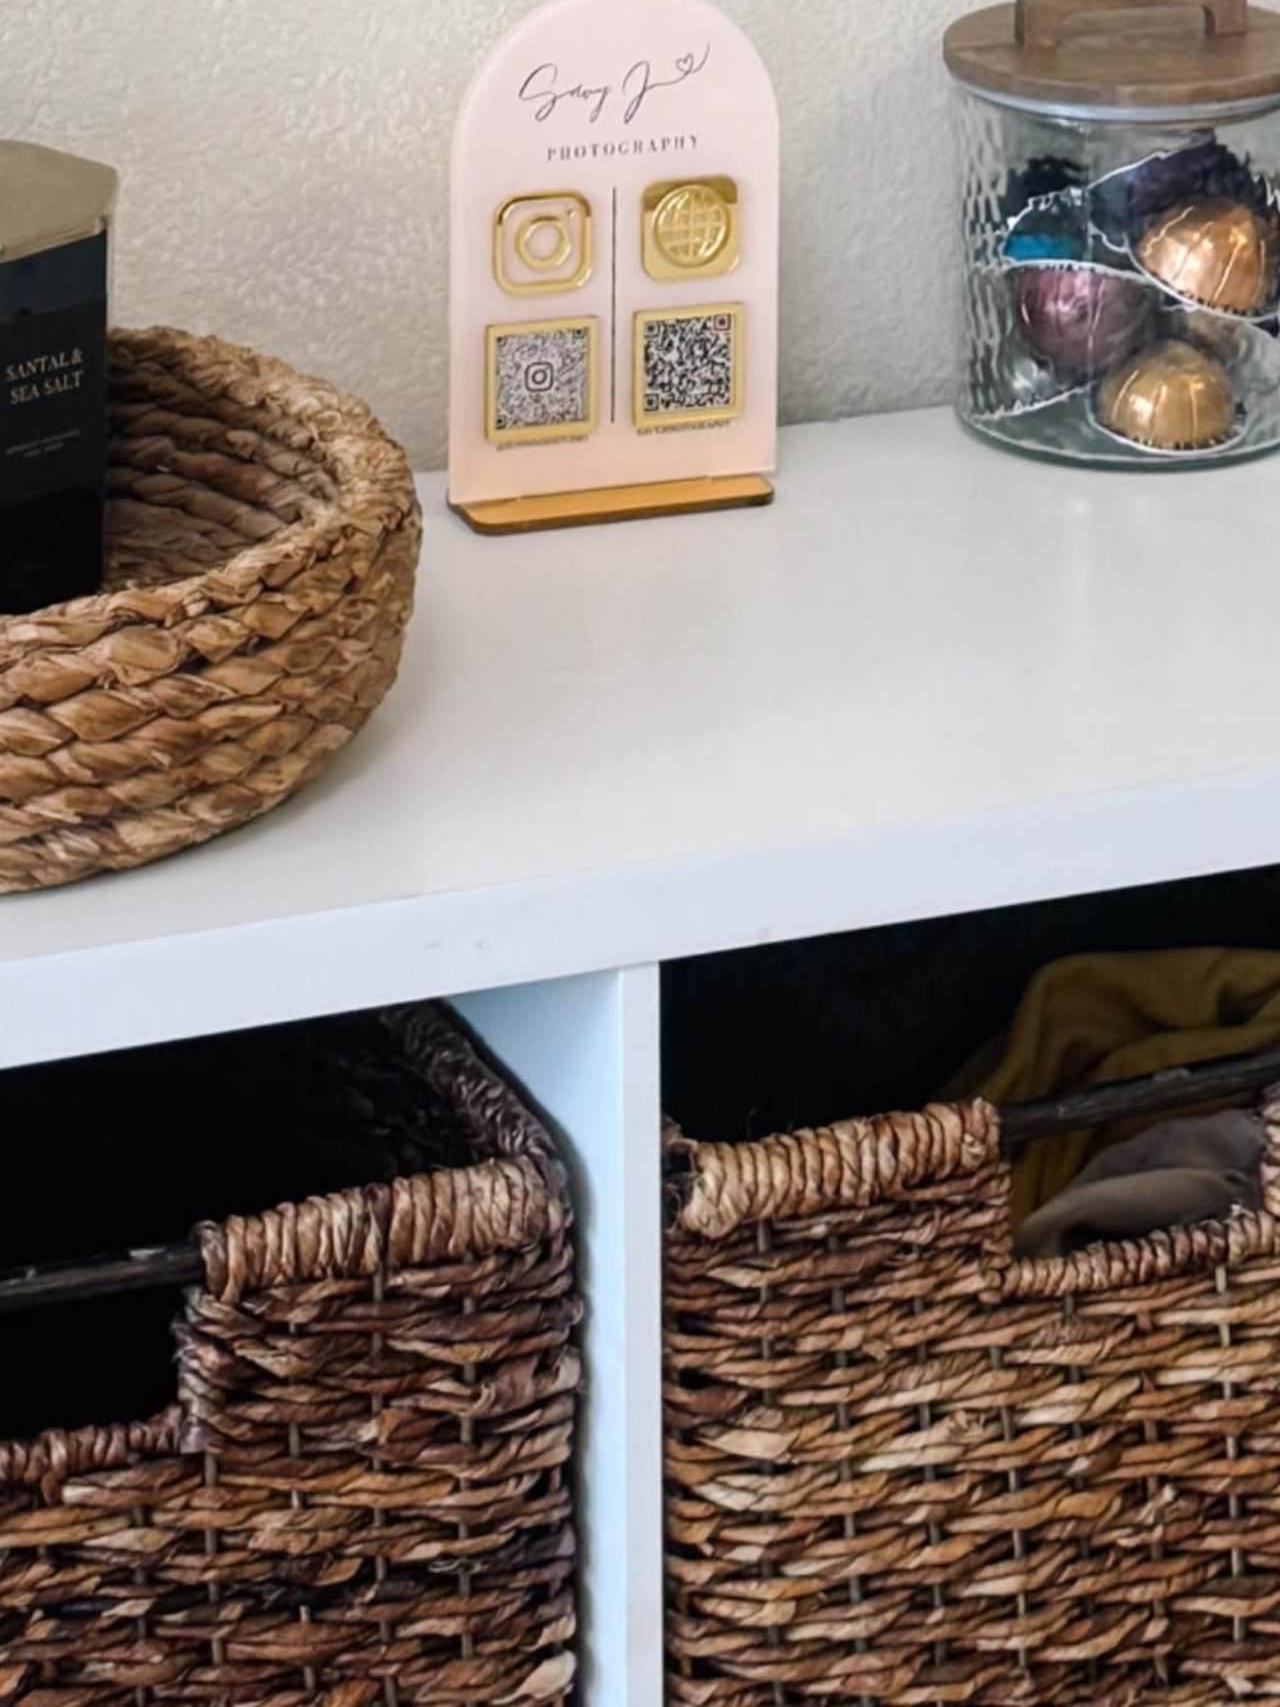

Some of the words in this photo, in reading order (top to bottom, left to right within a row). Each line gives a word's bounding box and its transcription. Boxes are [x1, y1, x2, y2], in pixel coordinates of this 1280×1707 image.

[547, 135, 697, 162] PHOTOGRAPHY
[5, 352, 70, 382] SANTAL
[10, 384, 40, 405] SEA
[43, 369, 84, 395] SALT
